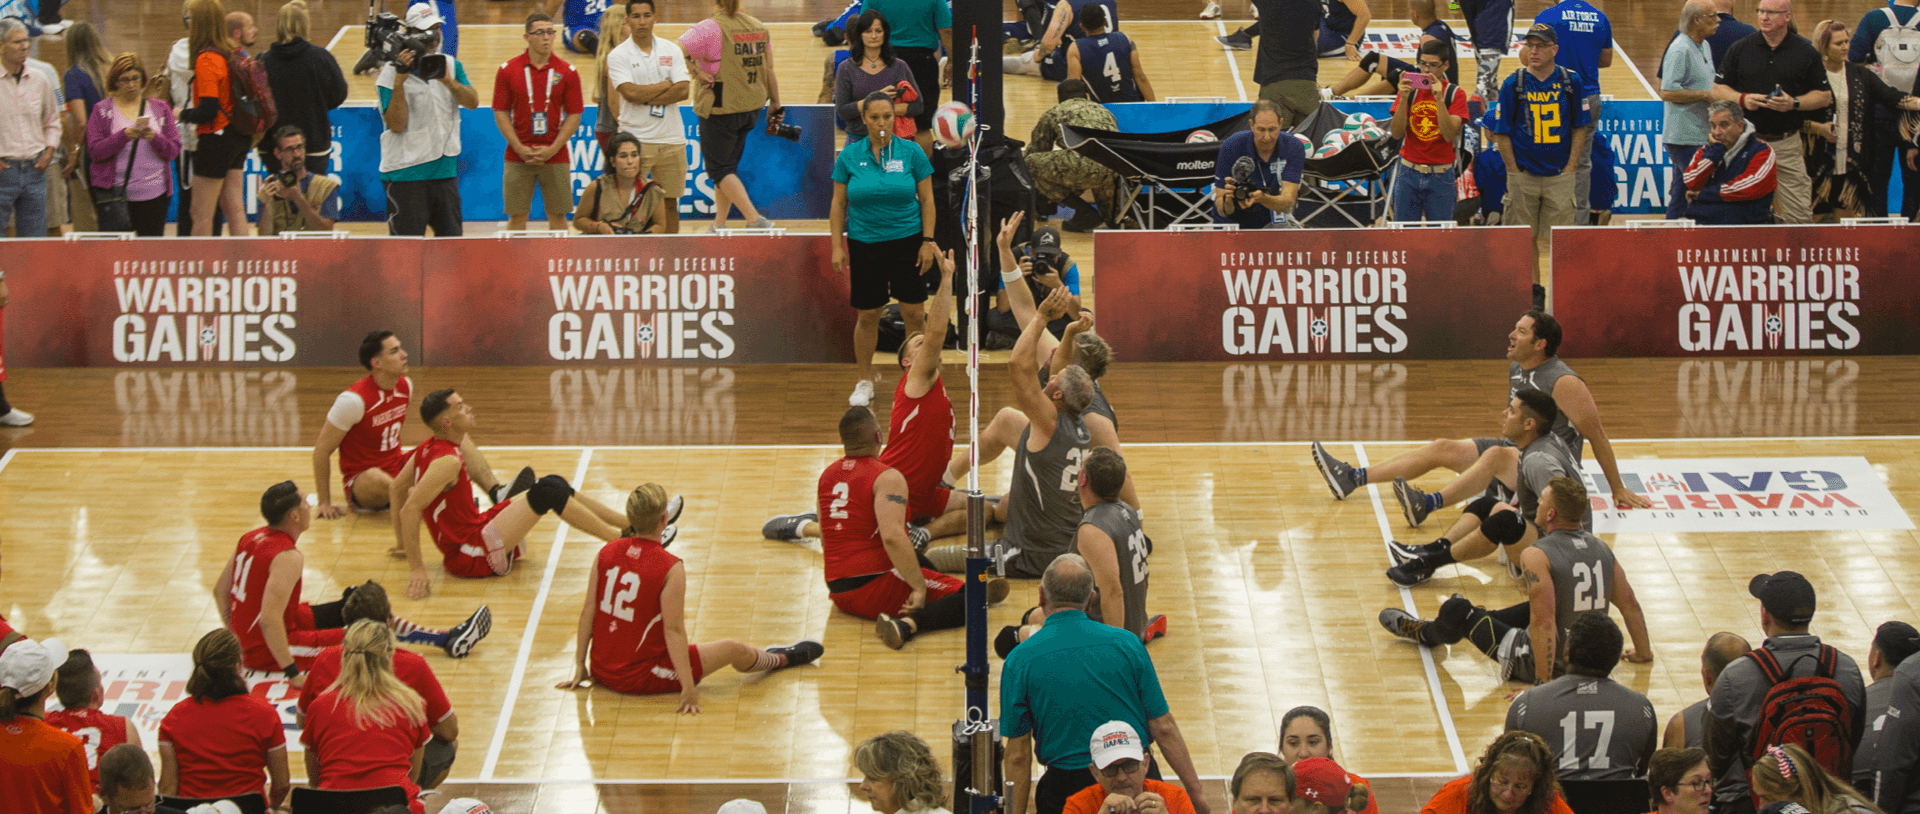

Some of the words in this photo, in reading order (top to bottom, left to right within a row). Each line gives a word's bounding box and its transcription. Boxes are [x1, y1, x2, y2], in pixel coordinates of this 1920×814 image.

[1561, 10, 1575, 20] AIR
[1576, 11, 1599, 22] FORCE
[1569, 21, 1594, 33] FAMILY
[1103, 51, 1121, 82] 4
[1527, 91, 1559, 102] NAVY
[1530, 103, 1561, 144] 12
[1176, 160, 1215, 170] molten
[114, 260, 204, 275] DEPARTMENT
[213, 260, 228, 275] OF
[237, 260, 297, 275] DEFENSE
[548, 257, 639, 272] DEPARTMENT
[649, 257, 665, 272] OF
[674, 257, 735, 272] DEFENSE
[1221, 251, 1312, 266] DEPARTMENT
[1321, 251, 1337, 266] OF
[1346, 251, 1407, 266] DEFENSE
[1677, 248, 1767, 262] DEPARTMENT
[1776, 248, 1791, 262] OF
[1801, 248, 1860, 262] DEFENSE
[114, 276, 297, 313] WARRIOR
[549, 273, 735, 310] WARRIOR
[1221, 267, 1407, 305] WARRIOR
[1678, 264, 1860, 302] WARRIOR
[112, 313, 297, 362] GAMES
[548, 310, 735, 360] GAMES
[1222, 305, 1408, 355] GAMES
[1678, 301, 1860, 351] GAMES
[829, 482, 849, 519] 2
[1128, 528, 1150, 584] 29
[231, 550, 254, 603] 11
[600, 565, 641, 623] 12
[1572, 560, 1606, 612] 21
[1559, 710, 1615, 769] 17
